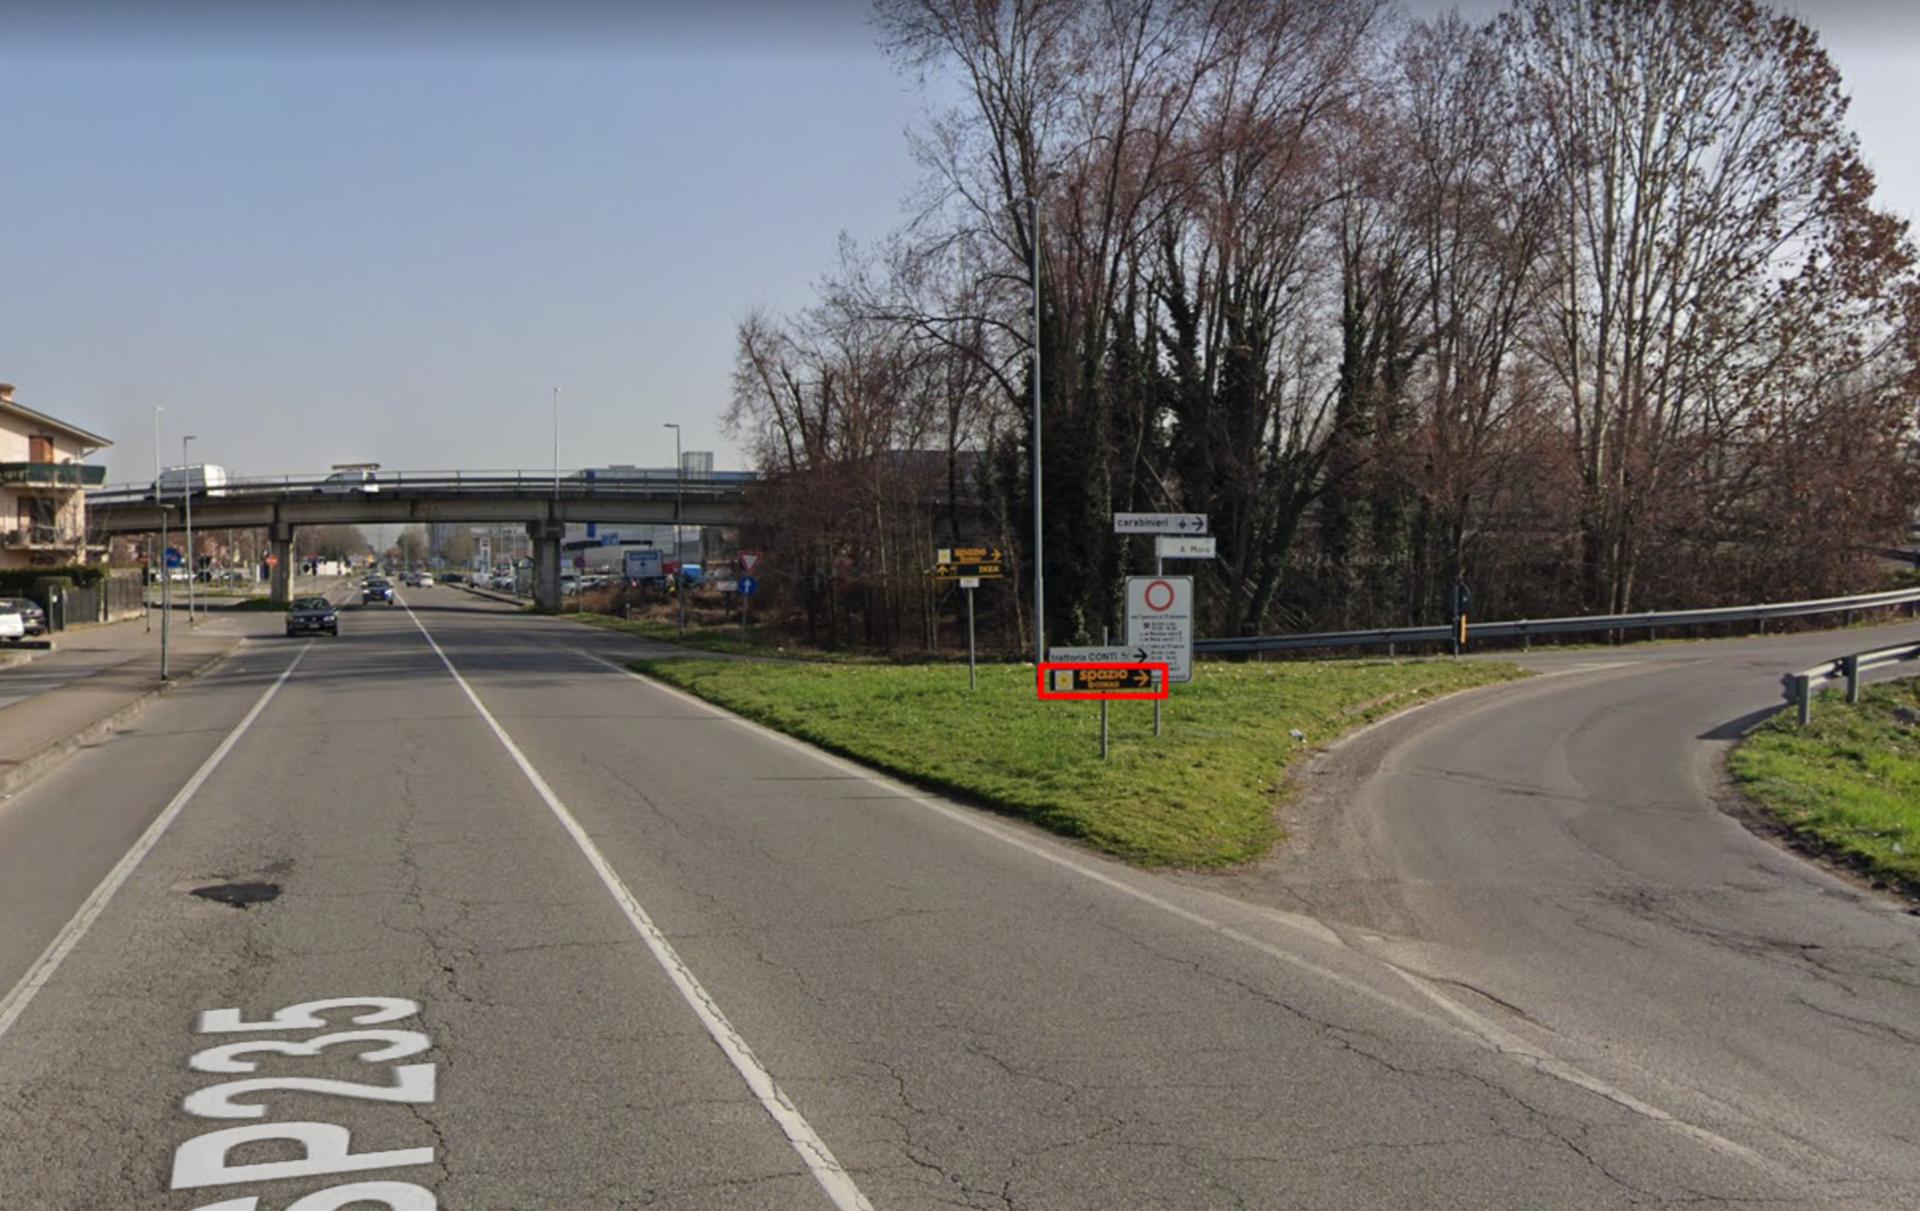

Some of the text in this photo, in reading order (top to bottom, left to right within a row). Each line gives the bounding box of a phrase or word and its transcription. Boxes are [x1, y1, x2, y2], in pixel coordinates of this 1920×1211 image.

[1117, 516, 1169, 528] carabinieri
[1051, 653, 1086, 661] trattoria
[1079, 669, 1128, 681] spazio
